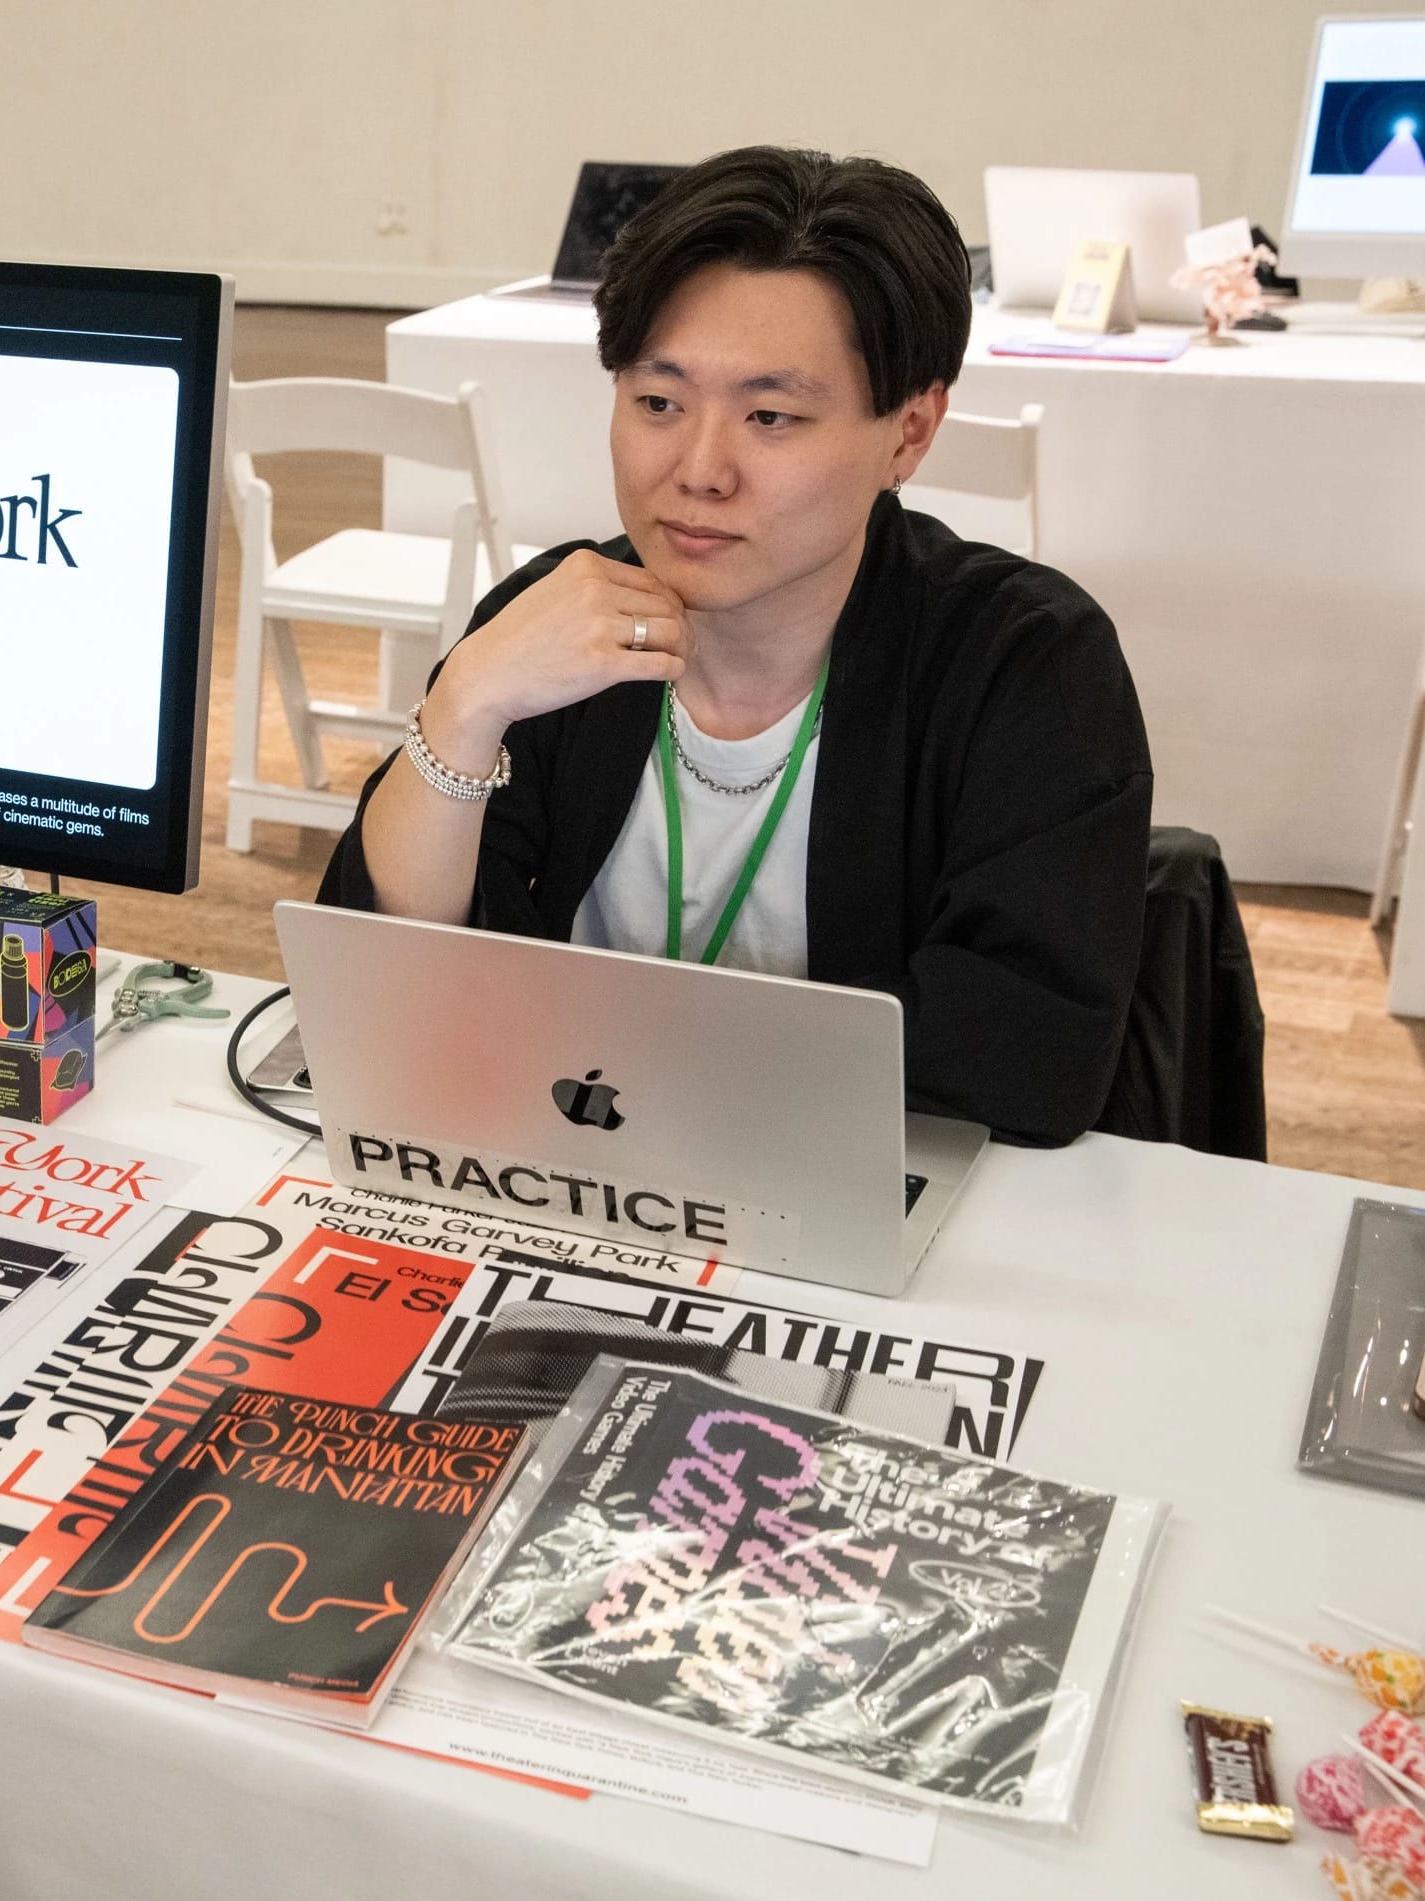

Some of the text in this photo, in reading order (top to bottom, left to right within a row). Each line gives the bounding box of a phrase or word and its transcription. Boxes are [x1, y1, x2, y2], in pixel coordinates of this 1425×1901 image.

[3, 808, 63, 831] cinematic
[66, 818, 104, 837] gems.
[31, 795, 38, 807] a
[41, 795, 99, 817] multitude
[103, 805, 116, 819] of
[119, 807, 149, 825] films
[54, 956, 87, 988] BODEGA
[4, 1130, 163, 1201] York
[347, 1133, 729, 1247] PRACTICE
[293, 1192, 430, 1227] Marcus
[441, 1219, 579, 1256] Garvey
[591, 1244, 683, 1273] Park
[316, 1216, 468, 1254] Sankofa
[229, 1391, 519, 1453] THE PUNCH GUIDE
[180, 1442, 242, 1475] IN
[206, 1413, 504, 1484] TO DRINKING
